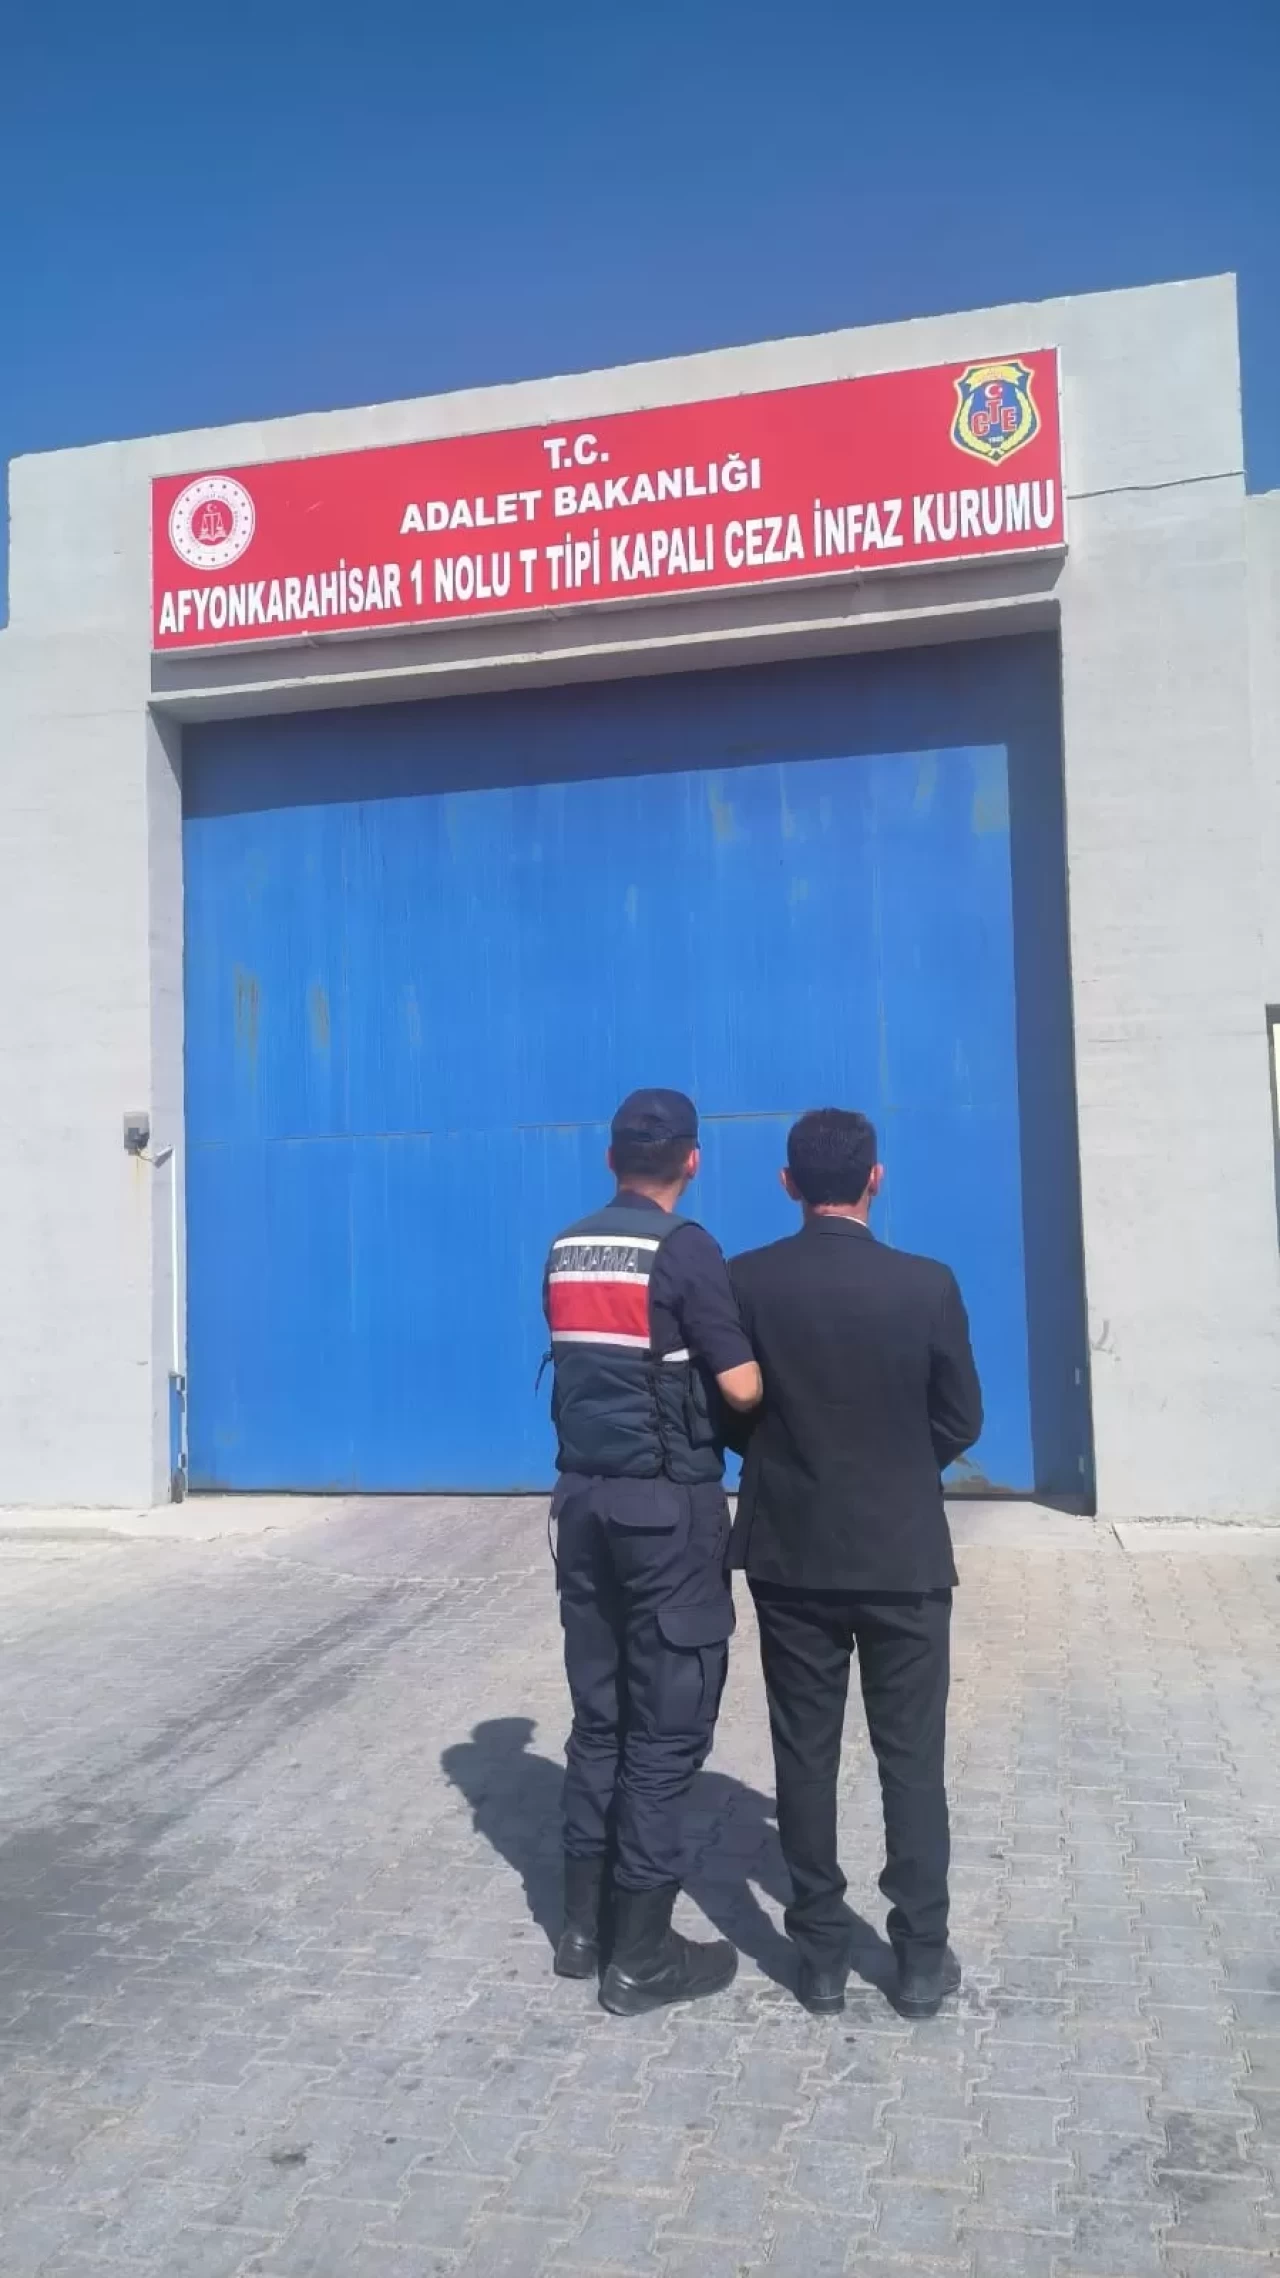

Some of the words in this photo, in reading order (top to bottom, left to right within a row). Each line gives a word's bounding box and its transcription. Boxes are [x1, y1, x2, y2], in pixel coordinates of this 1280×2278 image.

[543, 432, 609, 470] T.C.
[400, 490, 542, 535] ADALET
[554, 452, 762, 517] BAKANLIĞI
[158, 557, 403, 635] AFYONKARAHİSAR
[410, 559, 423, 605] 1
[434, 550, 511, 603] NOLU
[519, 547, 538, 593] T
[545, 526, 601, 590] TİPİ
[610, 523, 714, 582] KAPALI
[724, 512, 805, 569] CEZA
[813, 498, 904, 558] İNFAZ
[913, 479, 1055, 545] KURUMU
